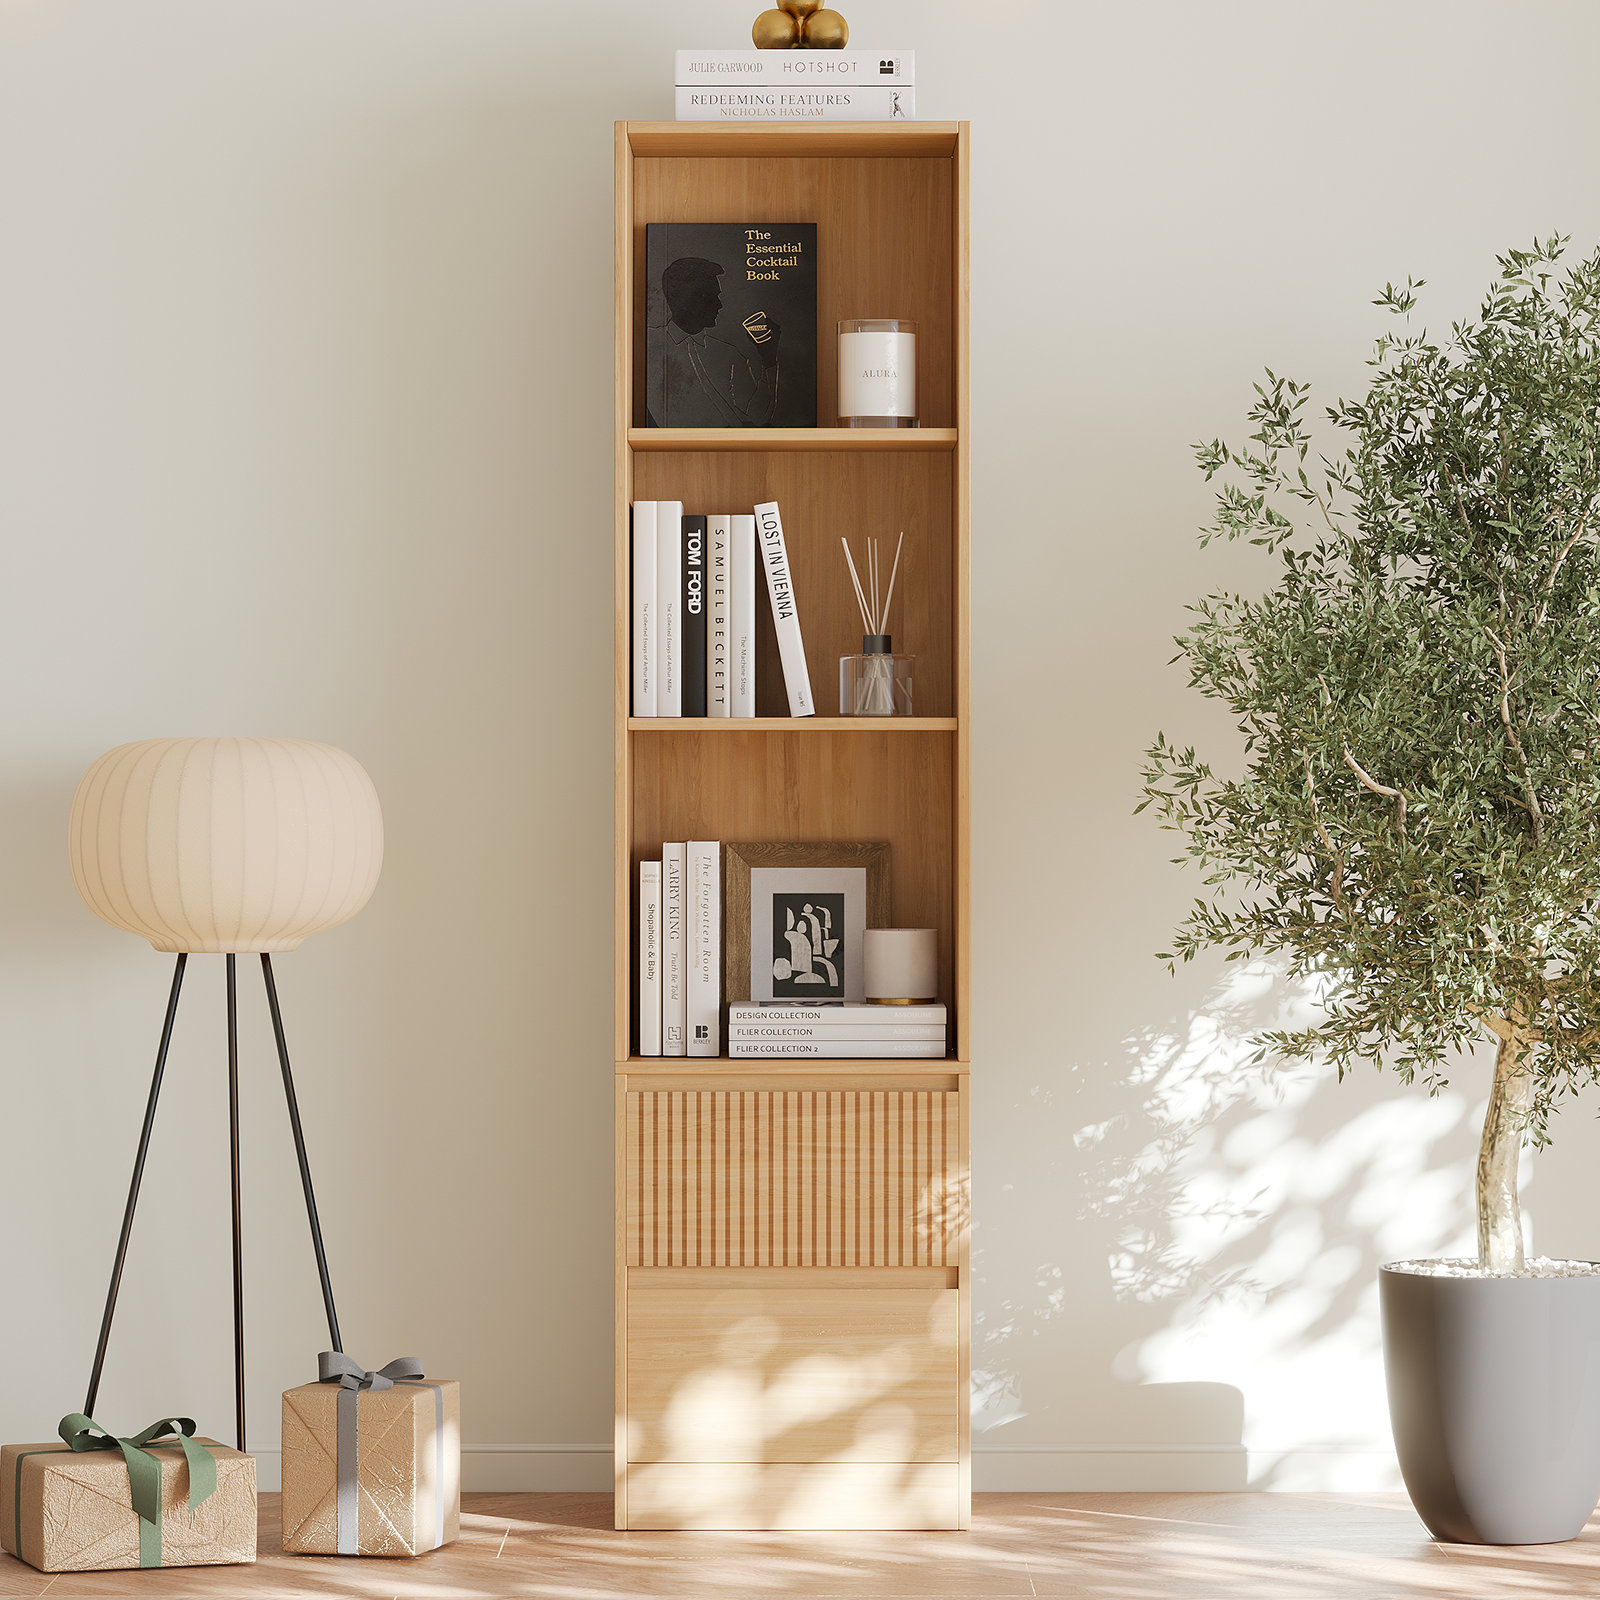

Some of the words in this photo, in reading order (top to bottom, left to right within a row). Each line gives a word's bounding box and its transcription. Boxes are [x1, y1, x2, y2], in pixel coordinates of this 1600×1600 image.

[689, 62, 716, 73] JULIE
[717, 62, 763, 73] GARWOOD
[783, 61, 858, 73] HOTSHOT
[691, 94, 775, 105] REDEEMING
[780, 94, 851, 106] FEATURES
[720, 107, 777, 117] NICHOLAS
[779, 107, 824, 117] HASLAM
[745, 229, 771, 240] The
[745, 242, 802, 254] Essential
[746, 255, 798, 267] Cocktail
[746, 269, 780, 281] Book
[862, 369, 897, 378] ALURA
[761, 511, 781, 547] LOST
[687, 529, 702, 566] TOM
[768, 552, 785, 565] IN
[714, 529, 725, 608] SAMUEL
[687, 570, 702, 614] FORD
[772, 568, 793, 620] VIENNA
[714, 617, 725, 704] BECKETT
[739, 678, 747, 696] Stops
[702, 855, 712, 877] The
[669, 858, 680, 902] LARRY
[700, 882, 712, 944] Forgotten
[646, 903, 656, 949] Shopaholic
[669, 906, 680, 940] KING
[647, 951, 656, 959] &
[671, 952, 679, 972] Truth
[646, 960, 656, 981] Baby
[702, 949, 712, 983] Room
[671, 974, 679, 983] Be
[671, 984, 679, 1000] Told
[736, 1011, 768, 1020] DESIGN
[768, 1011, 821, 1020] COLLECTION
[736, 1028, 760, 1036] FLIER
[760, 1028, 813, 1036] COLLECTION
[736, 1044, 759, 1053] FLIER
[760, 1044, 812, 1053] COLLECTION
